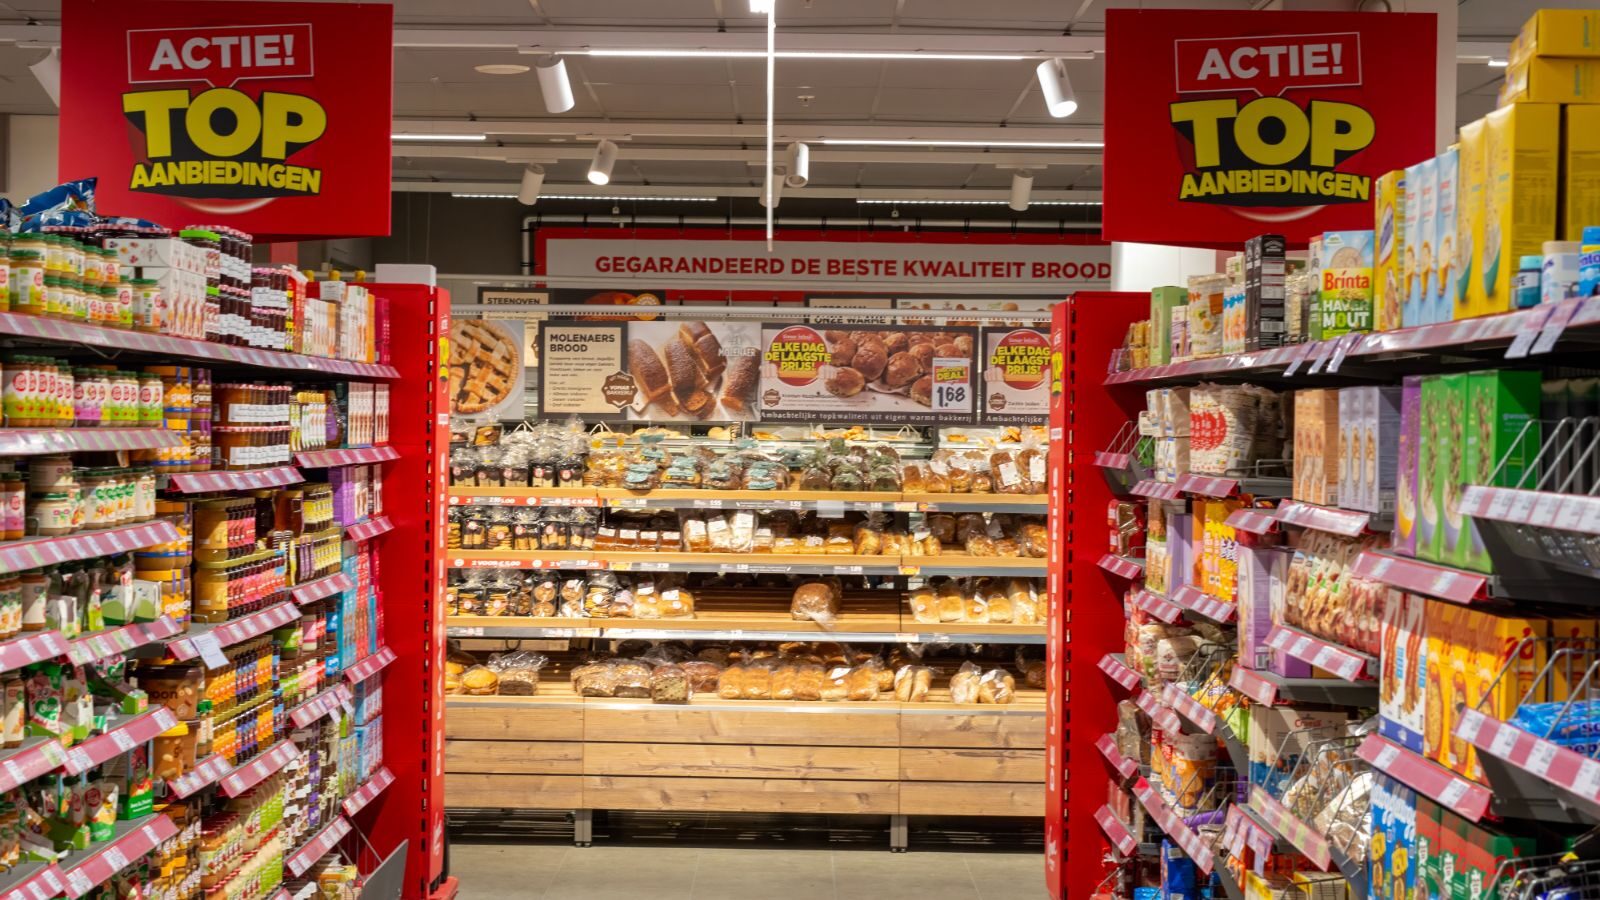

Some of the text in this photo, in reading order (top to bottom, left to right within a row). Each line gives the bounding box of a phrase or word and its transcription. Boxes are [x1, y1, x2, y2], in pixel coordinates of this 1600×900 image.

[149, 34, 294, 71] ACTIE!
[1197, 43, 1343, 81] ACTIE!
[122, 87, 327, 160] TOP
[1169, 97, 1376, 169] TOP
[130, 161, 321, 194] AANBIEDINGEN
[1179, 169, 1371, 201] AANBIEDINGEN
[595, 256, 1111, 280] GEGARANDEERD DE BESTE KWALITEIT BROOD
[1323, 270, 1370, 291] Brinta
[1323, 300, 1369, 311] HAVER
[1323, 312, 1370, 328] MOUT
[550, 334, 615, 342] MOLENAERS
[550, 344, 588, 352] BROOD
[771, 342, 825, 353] ELKE DAG
[997, 346, 1050, 356] ELKE DAG
[764, 352, 832, 362] DE LAAGSTE
[991, 356, 1050, 365] DE LAAGST
[781, 362, 817, 371] PRIJS!
[1007, 366, 1041, 375] PRIJS!
[760, 411, 816, 420] Ambachtelijke
[820, 412, 868, 420] topkwaliteit
[885, 414, 906, 422] eigen
[939, 414, 972, 423] bakkerij
[986, 415, 1043, 424] Ambachtelijke
[151, 690, 178, 699] oon
[1049, 745, 1055, 792] DE
